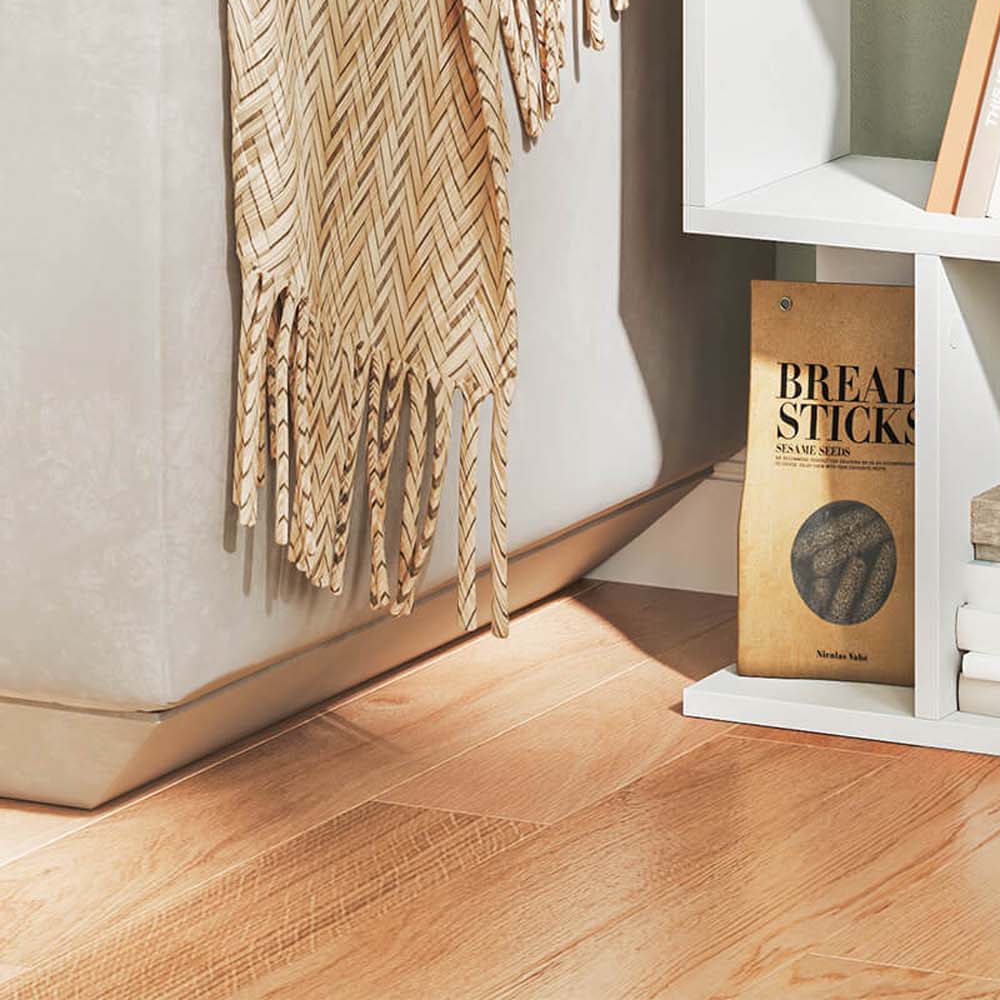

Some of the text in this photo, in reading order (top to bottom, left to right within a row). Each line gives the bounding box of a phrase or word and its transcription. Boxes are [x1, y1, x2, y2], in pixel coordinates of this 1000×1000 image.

[775, 361, 915, 405] BREAD
[775, 443, 851, 457] SESAME SEEDS
